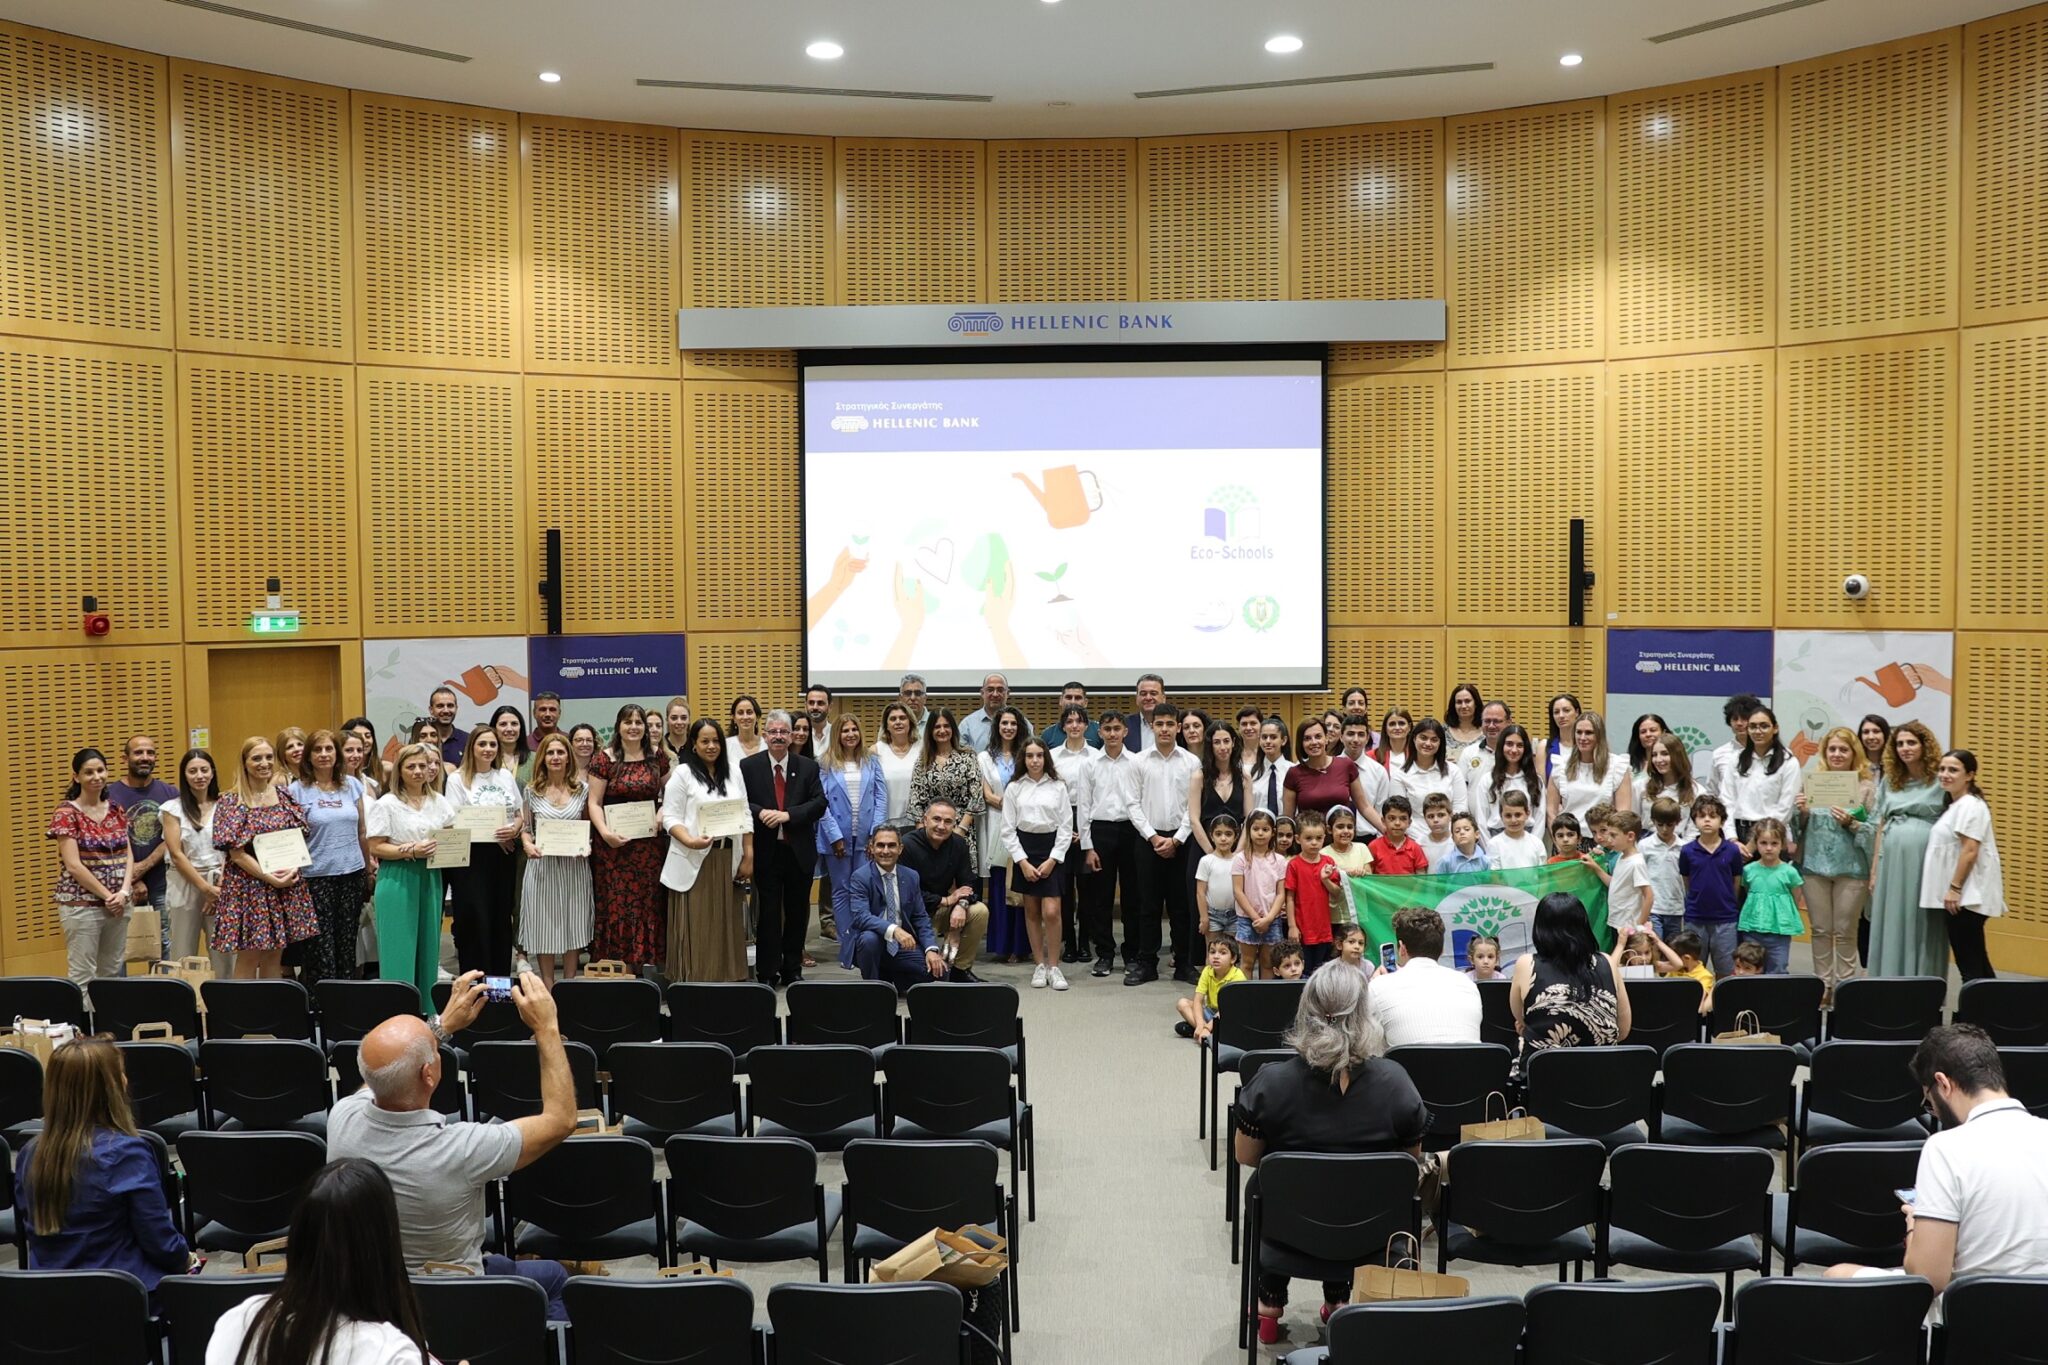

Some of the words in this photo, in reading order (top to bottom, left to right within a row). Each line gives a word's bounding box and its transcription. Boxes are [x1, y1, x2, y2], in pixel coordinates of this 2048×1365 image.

[1011, 314, 1109, 330] HELLENIC
[1118, 314, 1174, 329] BANK
[835, 402, 889, 412] Στρατηγικός
[891, 401, 943, 411] Συνεργάτης
[872, 417, 938, 429] HELLENIC
[943, 417, 980, 428] BANK
[1190, 546, 1274, 560] Eco-Schools
[587, 667, 631, 676] HELLENIC
[633, 666, 658, 674] BANK
[1663, 663, 1711, 672] HELLENIC
[1713, 664, 1741, 673] BANK
